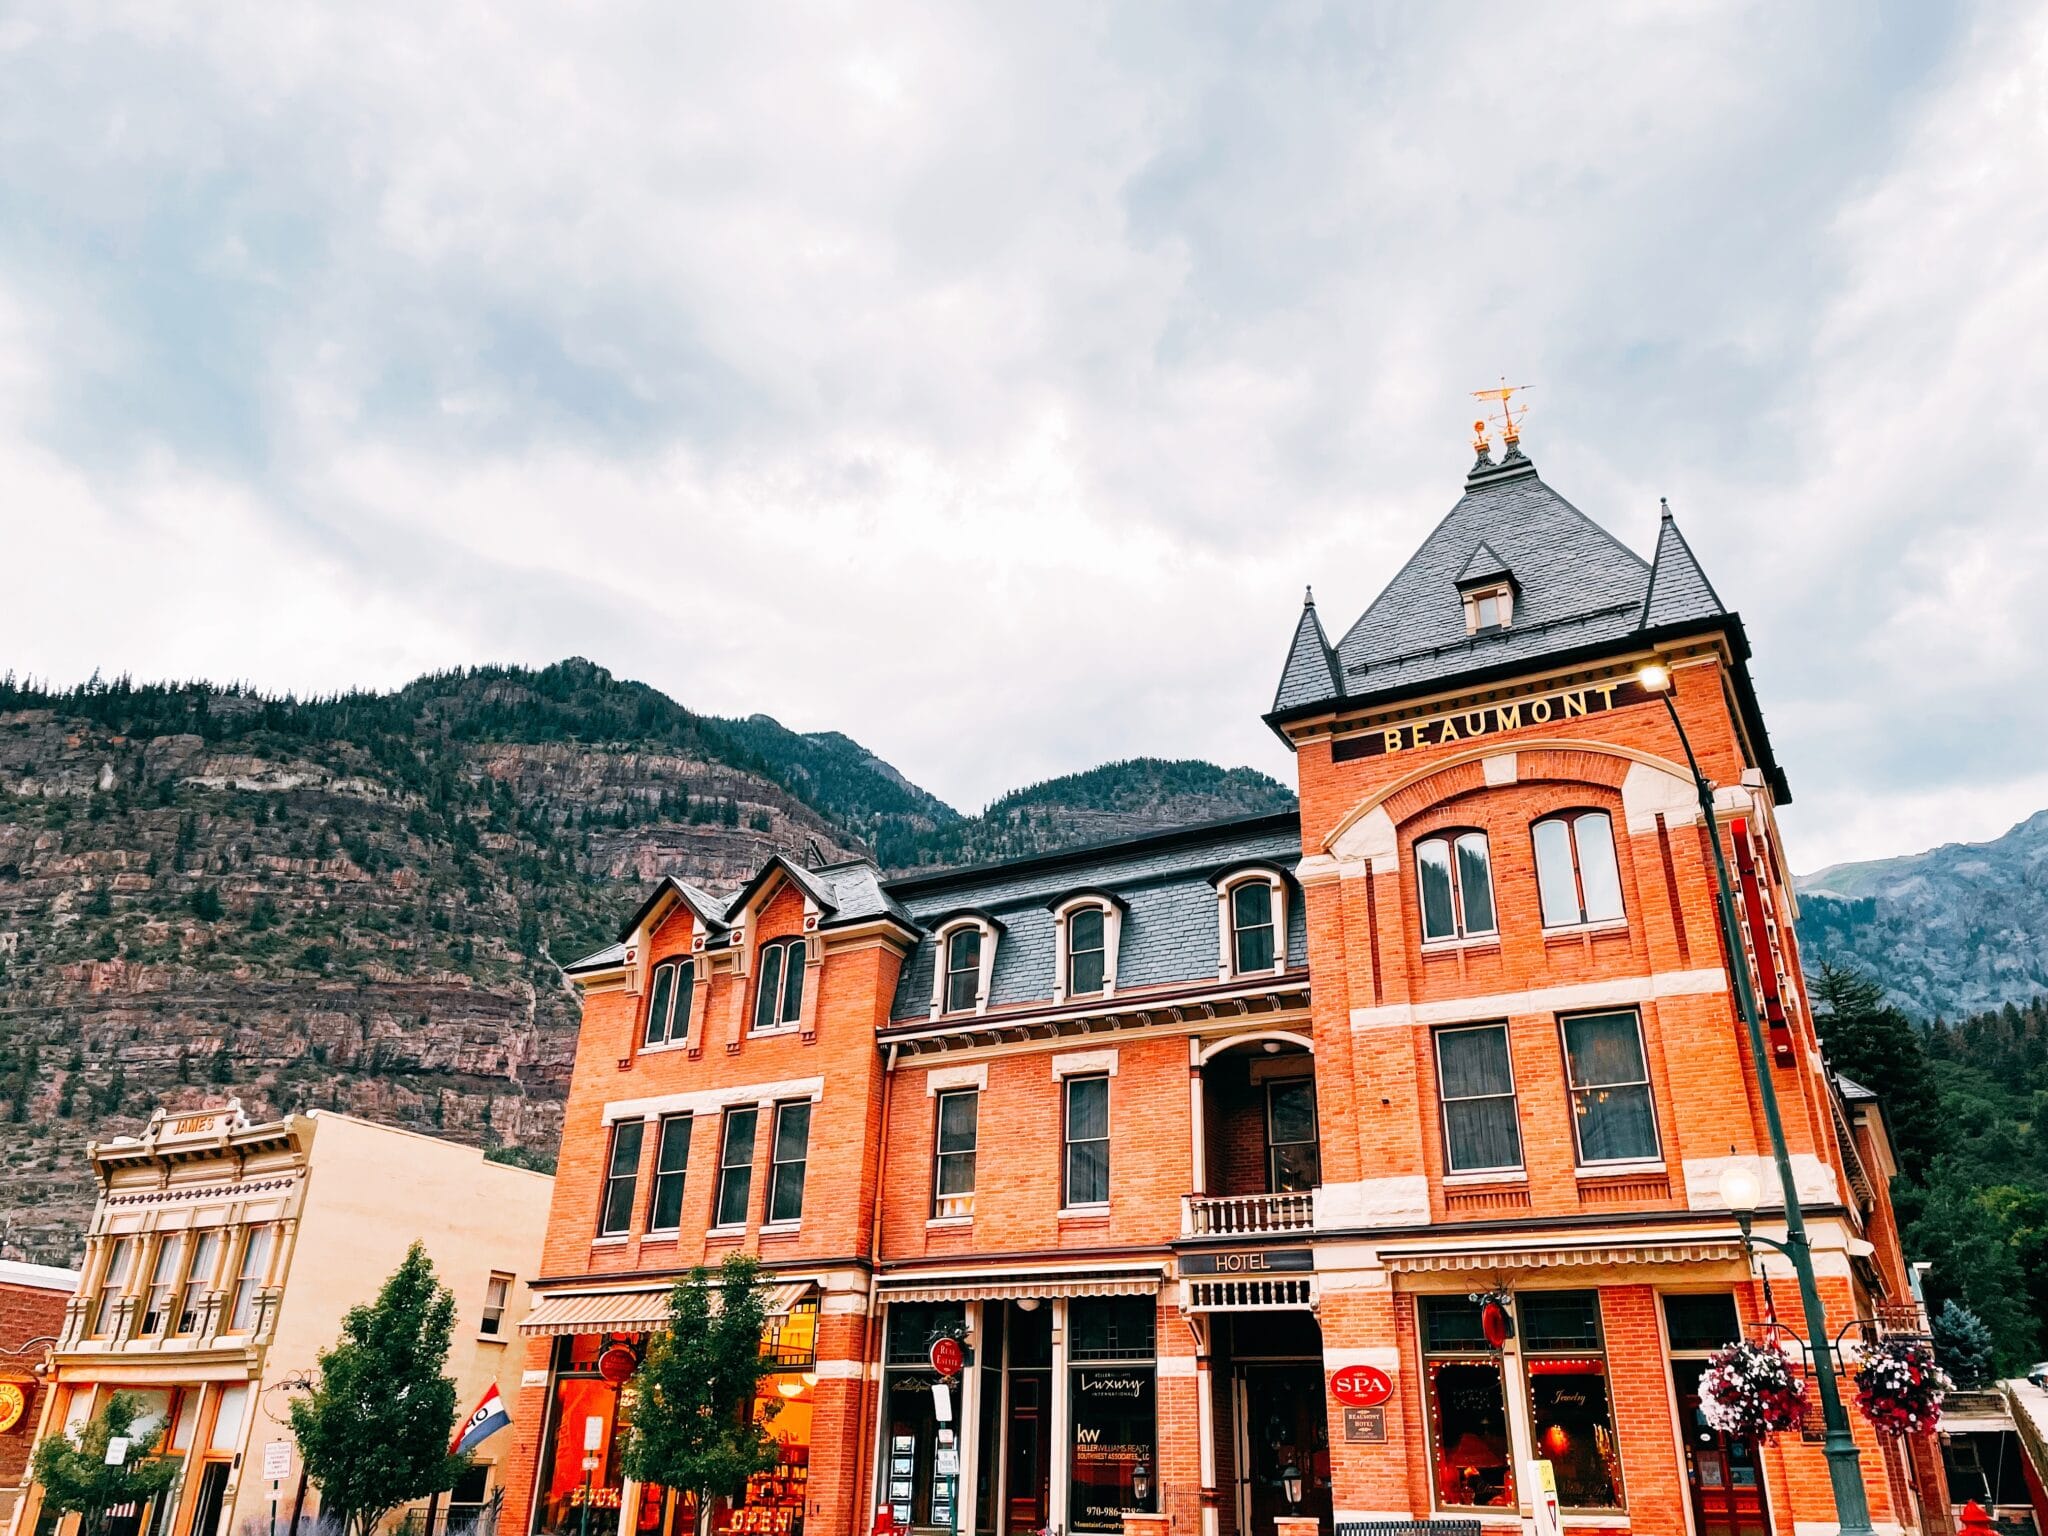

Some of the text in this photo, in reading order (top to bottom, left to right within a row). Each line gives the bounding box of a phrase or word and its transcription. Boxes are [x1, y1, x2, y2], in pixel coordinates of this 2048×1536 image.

[1383, 684, 1618, 754] BEAUMONT
[173, 1116, 215, 1135] JAMES
[1216, 1253, 1271, 1271] HOTEL
[1081, 1373, 1145, 1398] Luxury
[1336, 1378, 1386, 1393] SPA
[1550, 1389, 1586, 1407] Jewelry
[1077, 1423, 1101, 1443] kw
[731, 1510, 788, 1533] OPEN
